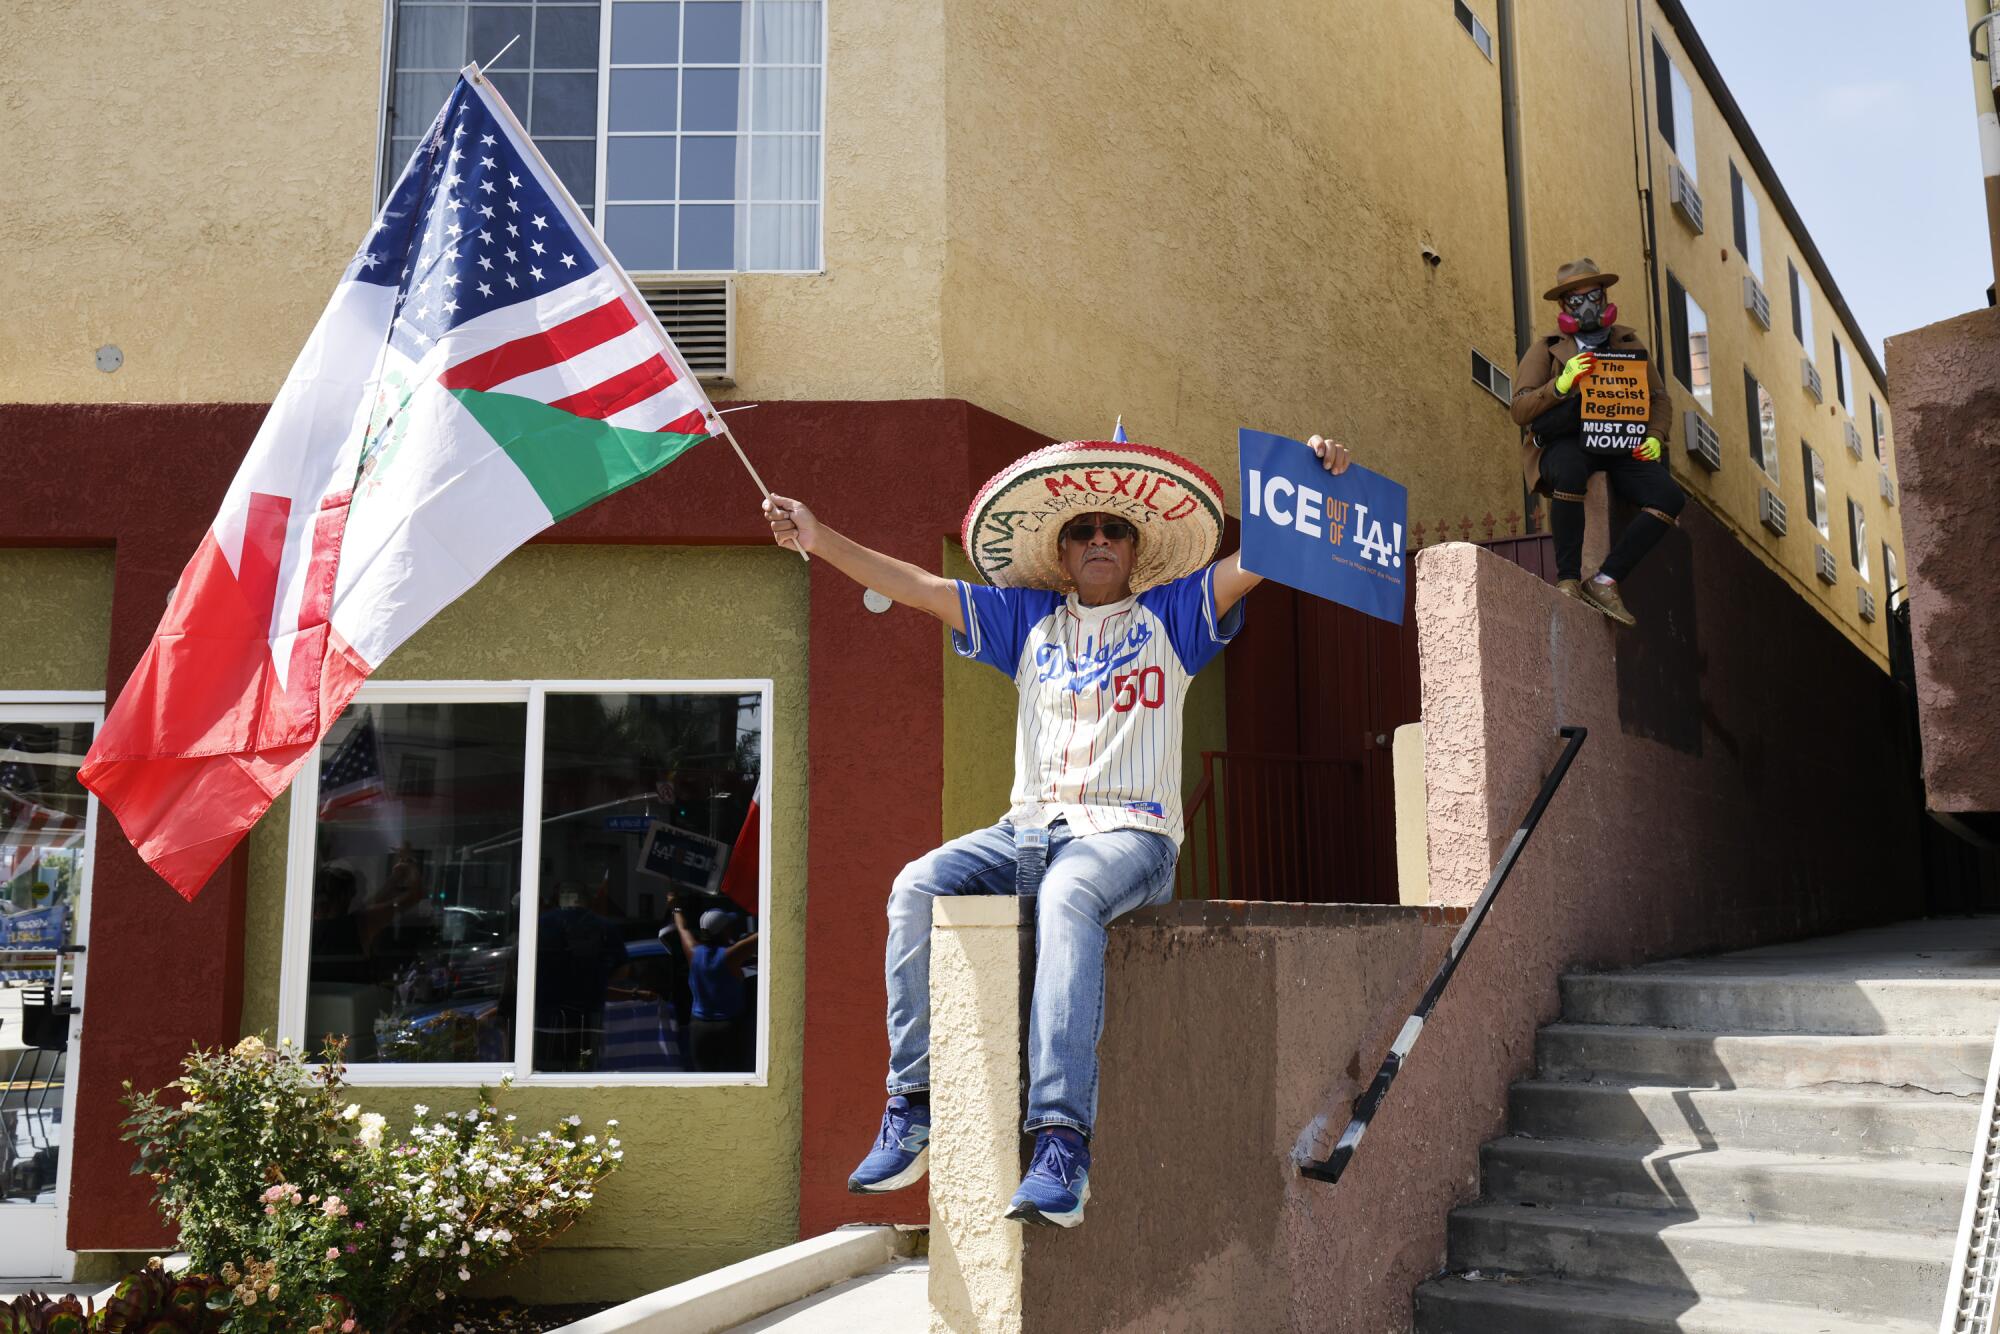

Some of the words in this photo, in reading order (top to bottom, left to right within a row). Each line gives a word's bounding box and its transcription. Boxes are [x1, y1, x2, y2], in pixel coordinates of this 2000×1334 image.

[1590, 374, 1638, 387] Trump
[1602, 362, 1624, 372] The
[1586, 388, 1645, 400] Fascist
[1585, 401, 1645, 417] Regime
[1583, 421, 1622, 433] MUST
[1626, 423, 1646, 434] GO
[1585, 435, 1641, 448] NOW!!!
[1017, 492, 1158, 533] CABRONES
[1249, 469, 1323, 538] ICE
[1326, 496, 1349, 525] OUT
[982, 510, 1028, 571] VIVA
[1043, 470, 1198, 521] MEXICO
[1329, 522, 1344, 547] OF
[1353, 503, 1402, 568] LA!
[1035, 622, 1152, 691] Dodgers
[1112, 666, 1165, 712] 50
